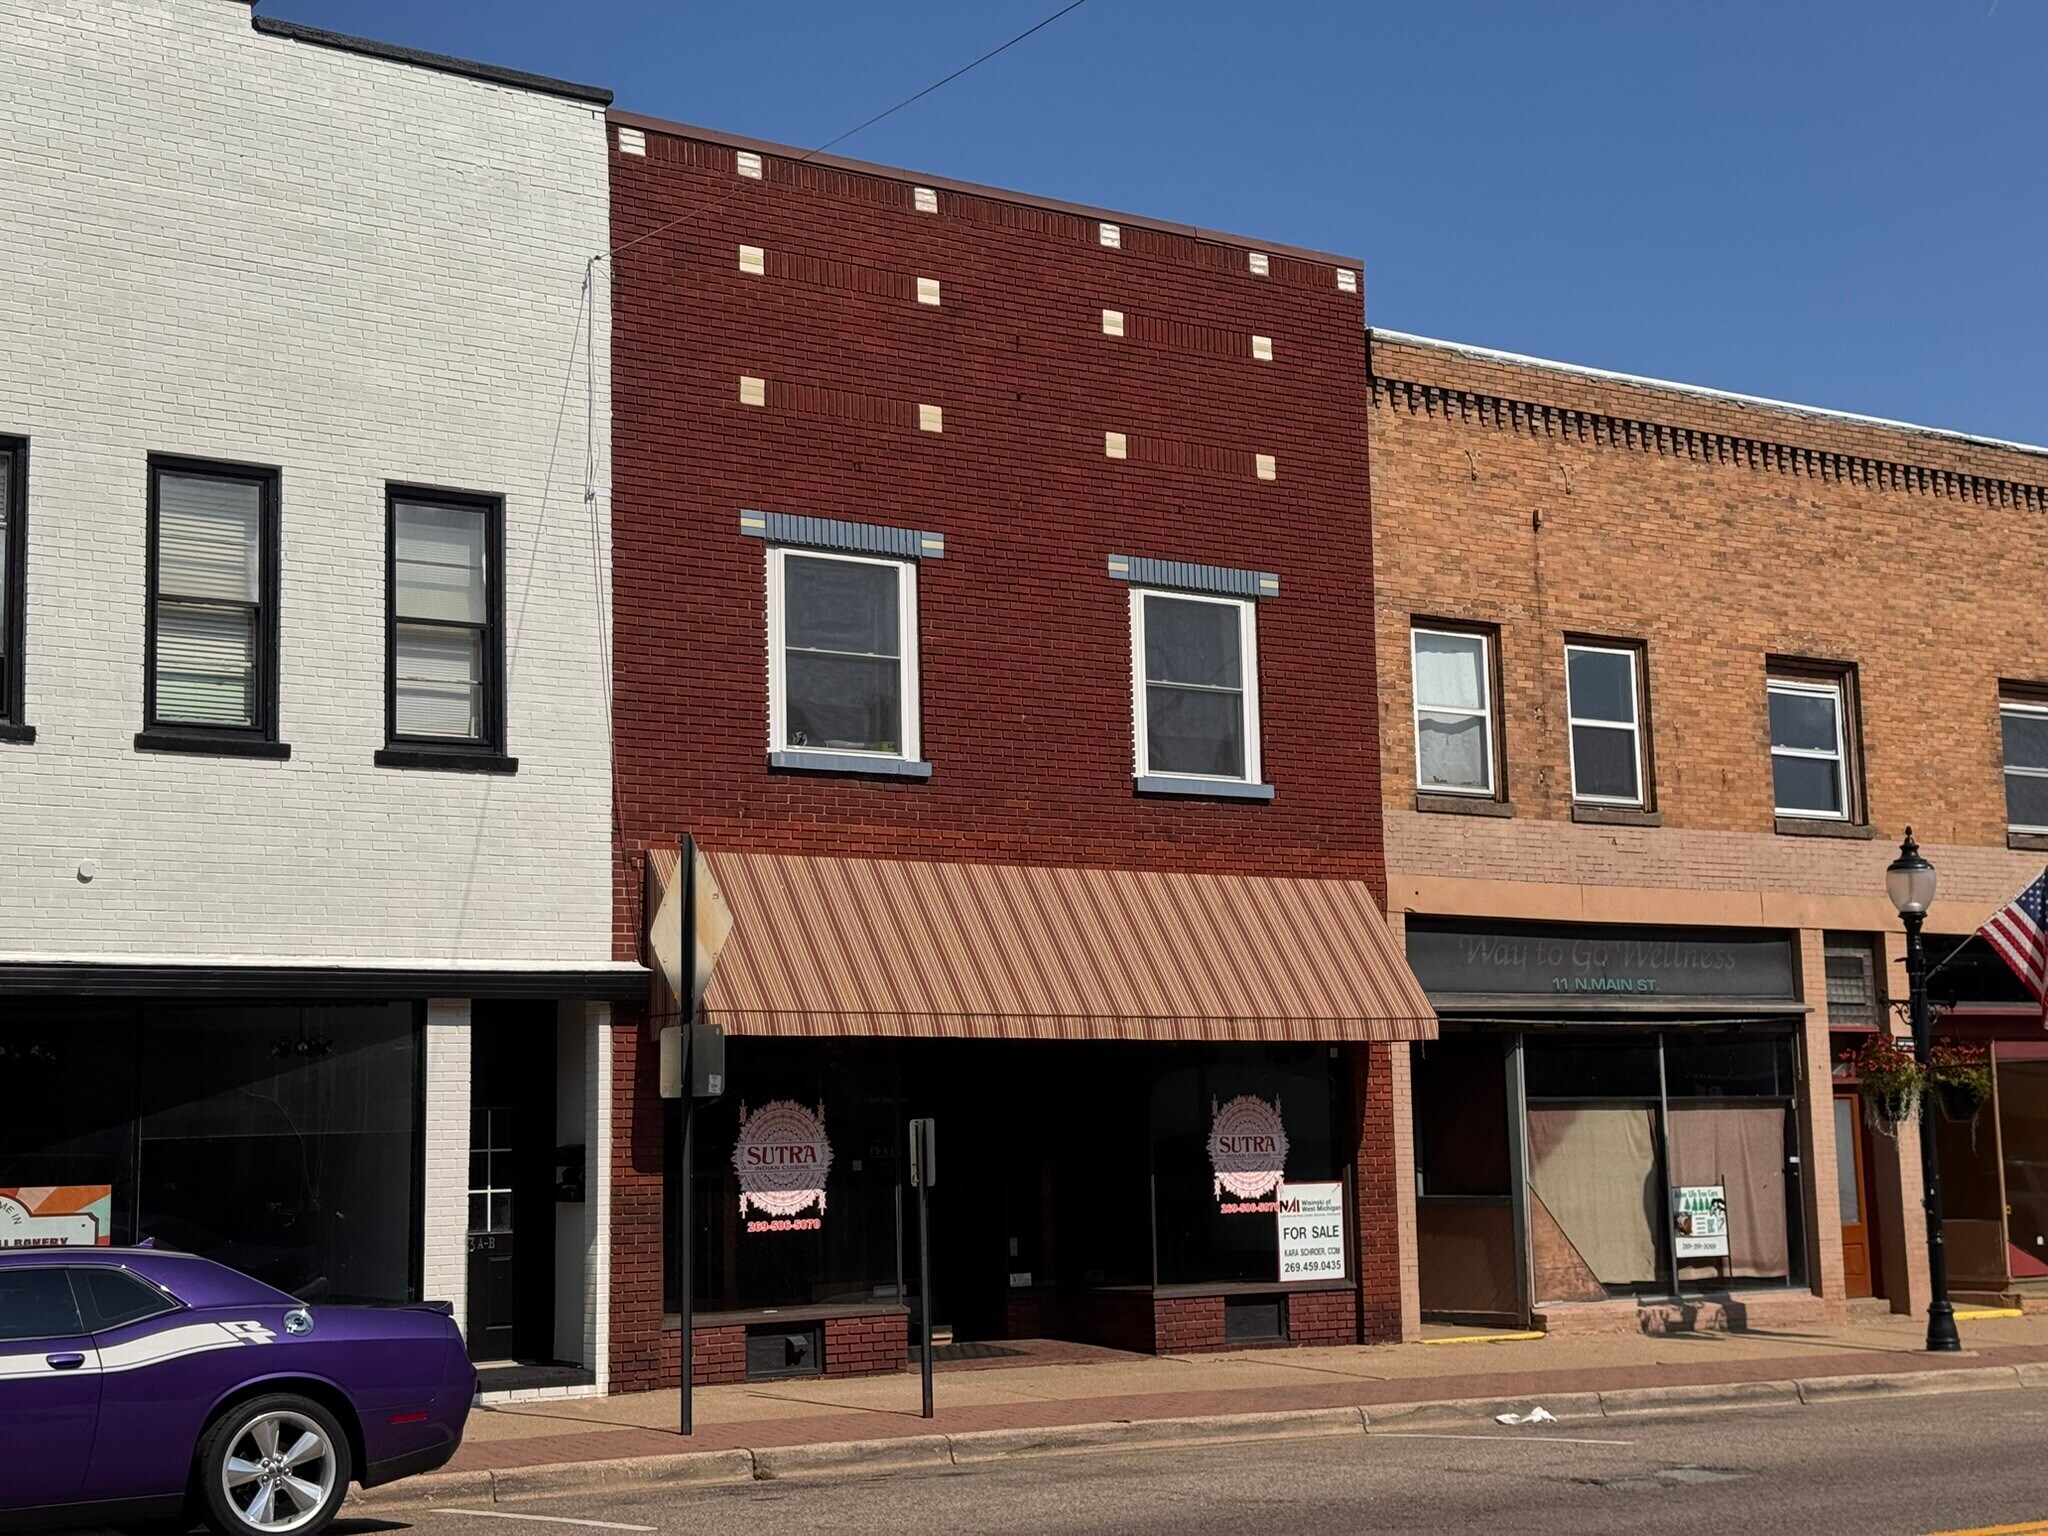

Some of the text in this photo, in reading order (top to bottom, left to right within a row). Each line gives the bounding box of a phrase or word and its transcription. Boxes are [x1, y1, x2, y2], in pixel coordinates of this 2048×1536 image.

[1460, 936, 1737, 975] Way to Go Wellness
[1552, 977, 1568, 990] 11
[1637, 979, 1660, 992] ST.
[1219, 1135, 1276, 1153] SUTRA
[746, 1144, 817, 1165] SUTRA
[1280, 1196, 1300, 1213] NAI
[1283, 1225, 1340, 1240] FOR SALE
[1284, 1248, 1299, 1257] KARA
[1284, 1260, 1342, 1273] 269.459.0435
